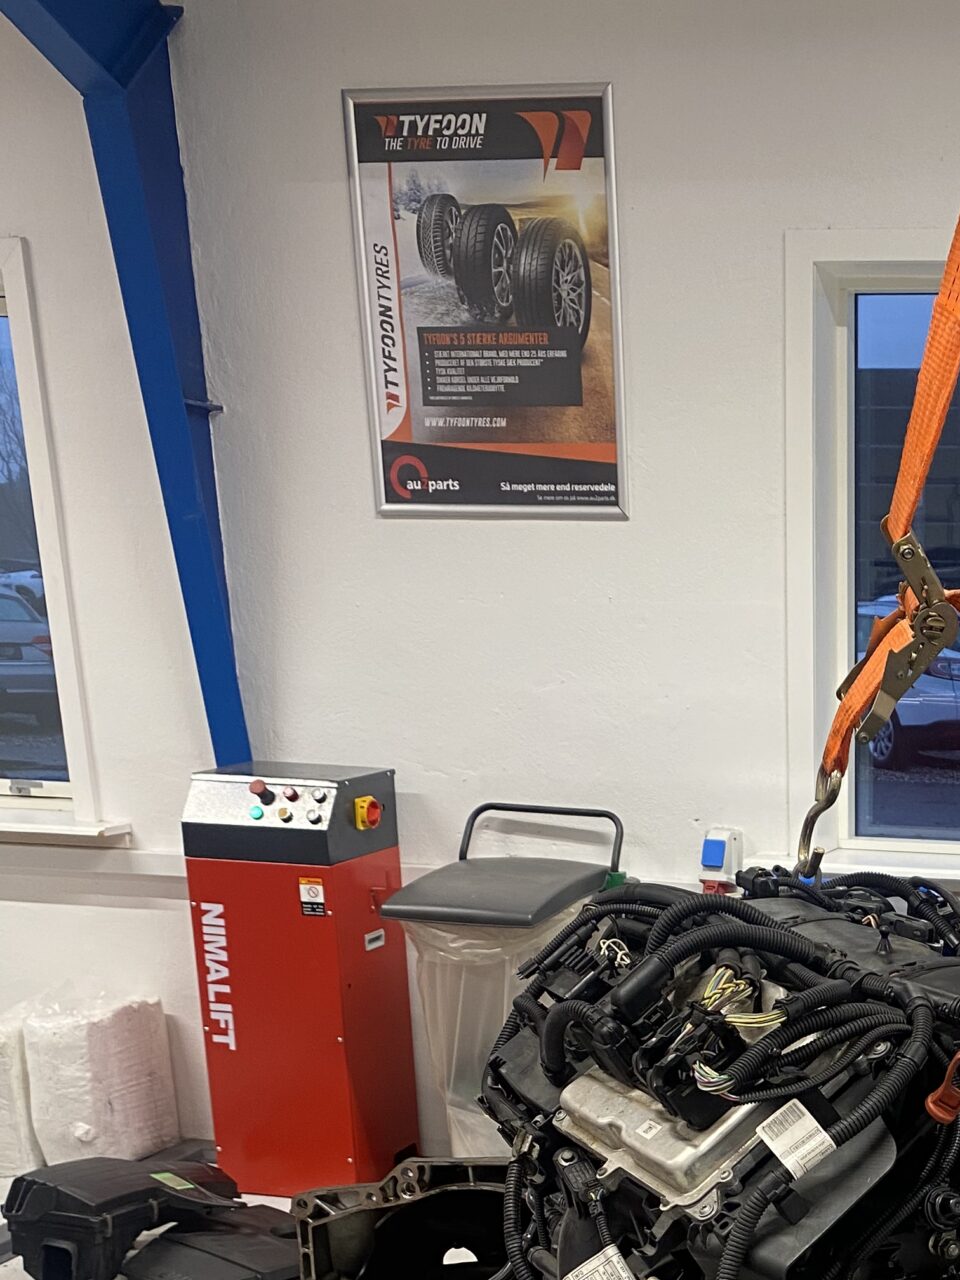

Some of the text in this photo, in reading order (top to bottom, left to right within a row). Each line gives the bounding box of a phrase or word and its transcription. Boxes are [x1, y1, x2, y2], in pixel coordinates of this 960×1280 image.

[399, 113, 487, 136] TYFOON
[385, 135, 484, 150] THE TYRE TO DRIVE
[499, 332, 549, 345] ARGUMENTER
[424, 417, 507, 427] WWW.TYFOONTYRES.COM
[500, 481, 511, 491] Så
[512, 483, 535, 493] meget
[556, 483, 571, 491] end
[571, 483, 616, 492] reservedele
[200, 902, 236, 1051] NIMALIFT
